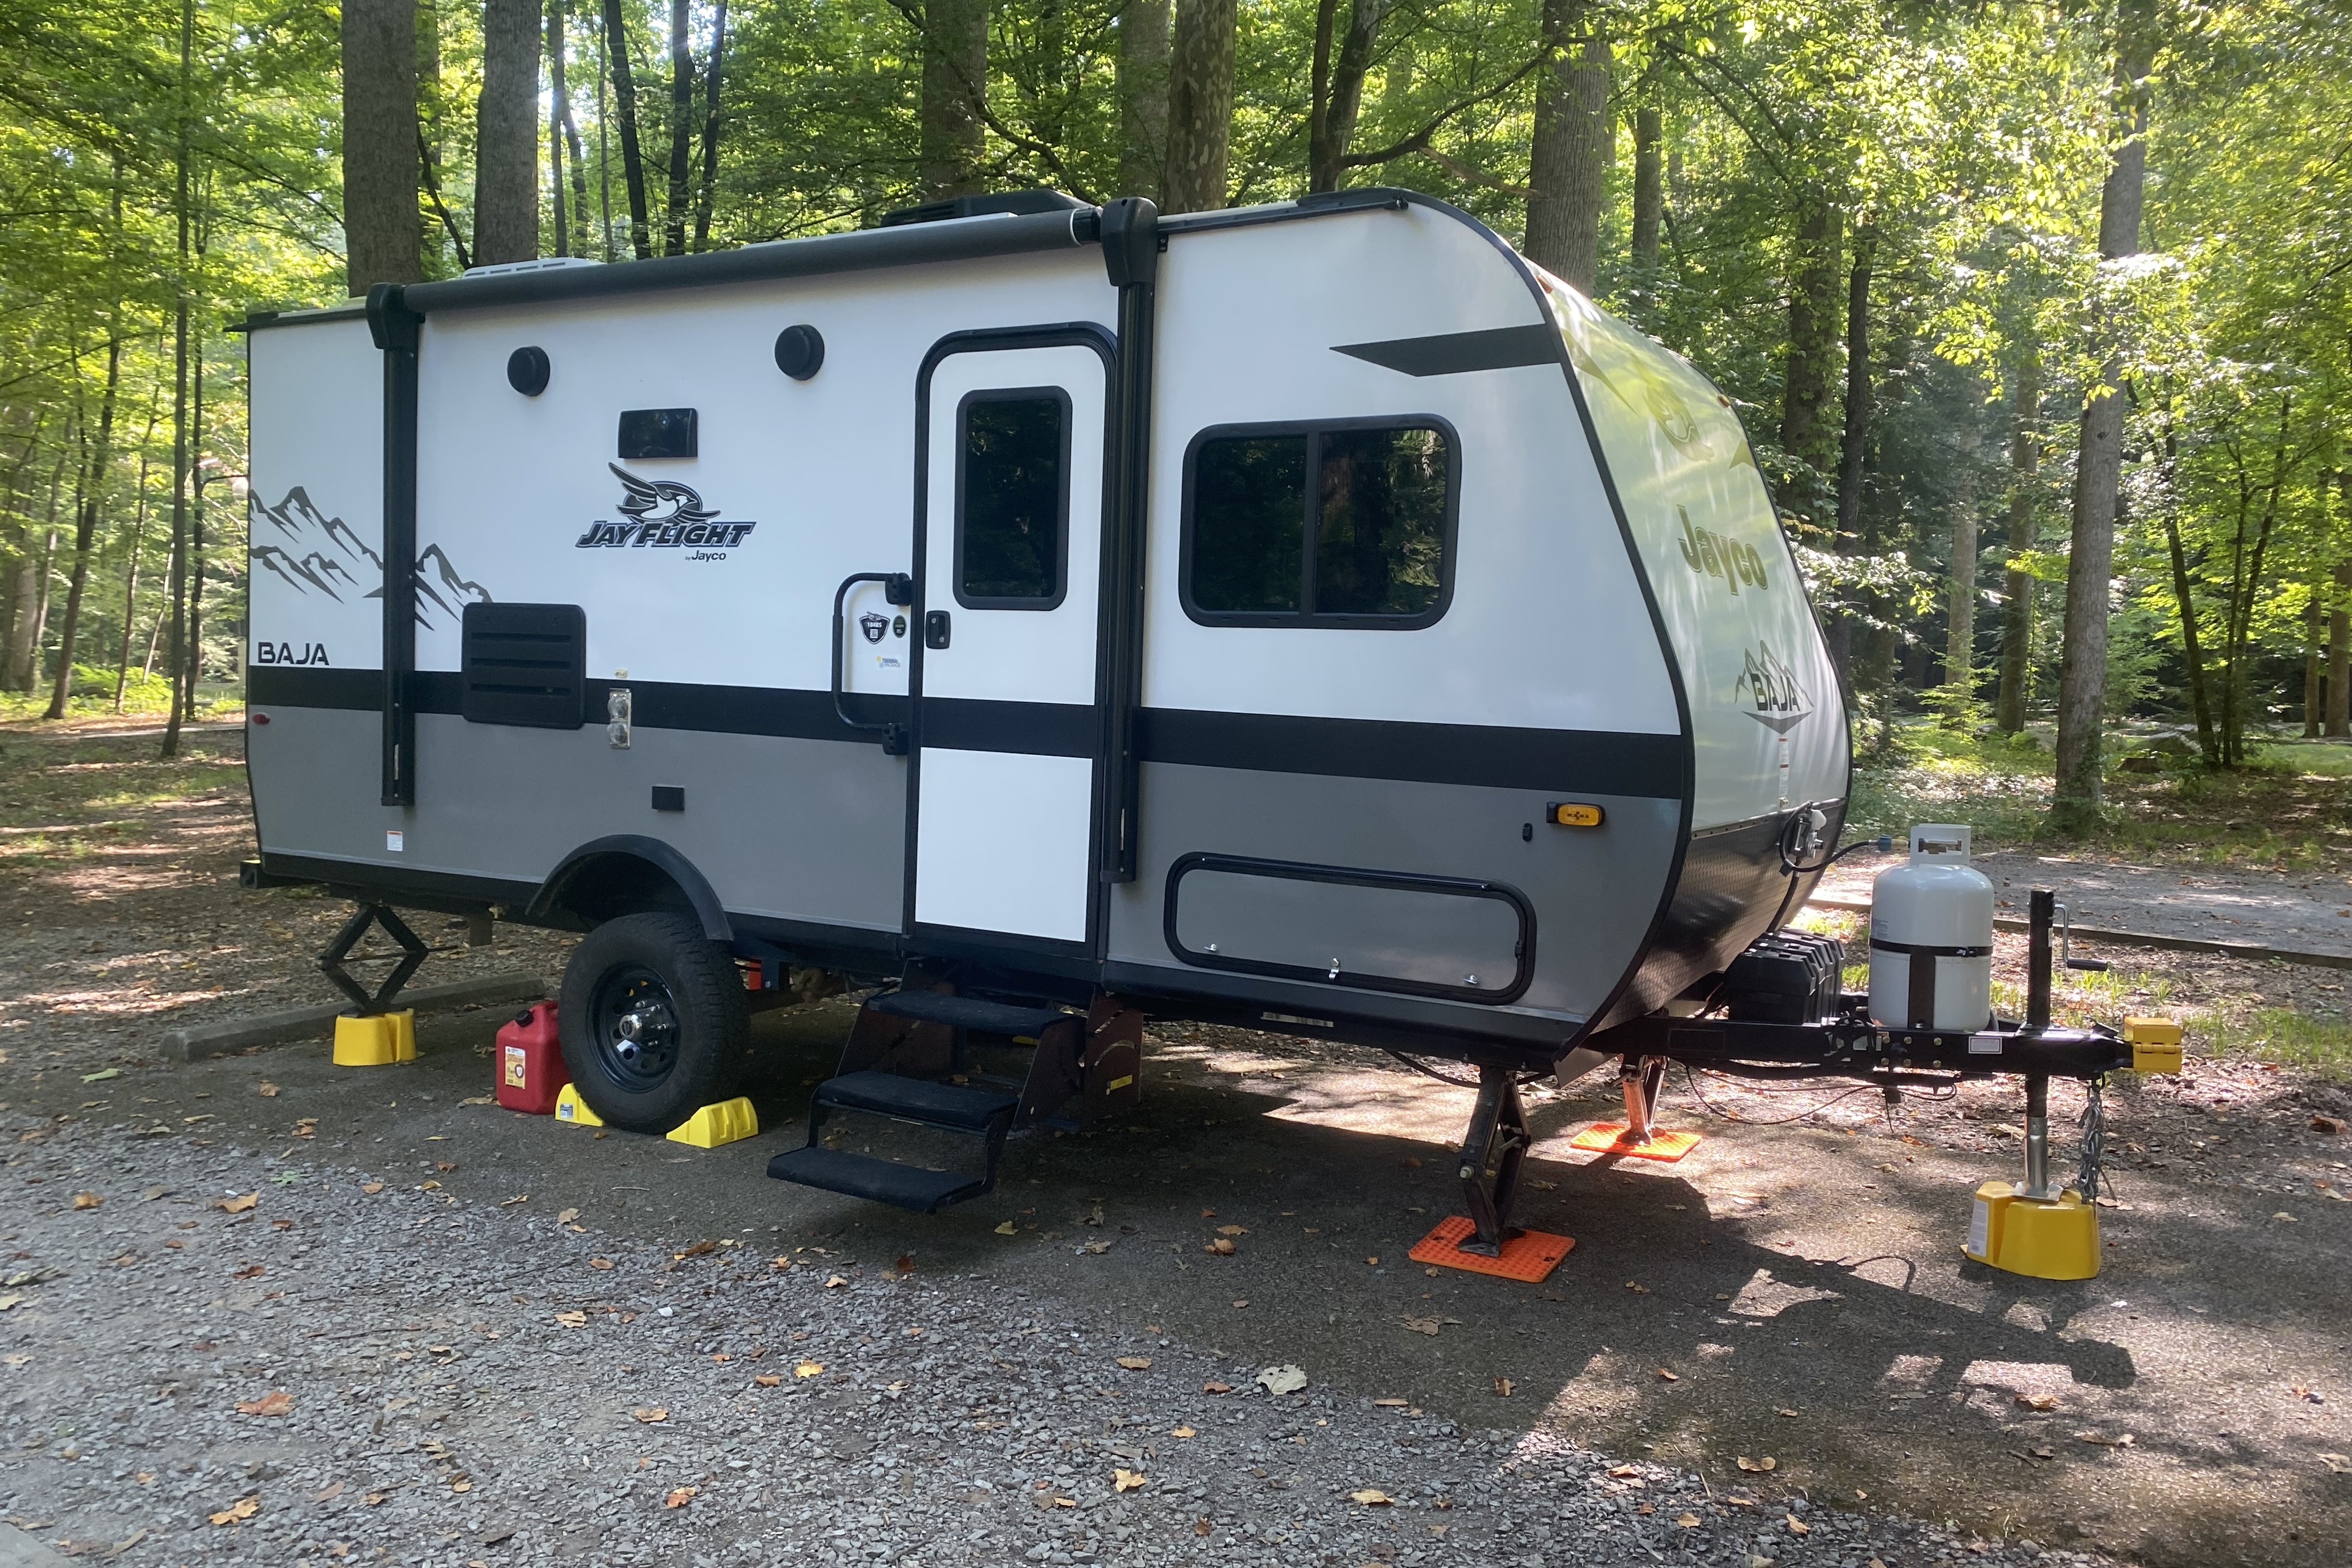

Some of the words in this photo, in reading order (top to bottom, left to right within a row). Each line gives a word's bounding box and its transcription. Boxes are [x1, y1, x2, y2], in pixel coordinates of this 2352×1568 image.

[691, 550, 726, 562] Jayco
[1677, 505, 1768, 595] Jayco
[258, 642, 329, 665] BAJA
[1750, 673, 1800, 711] BAJA
